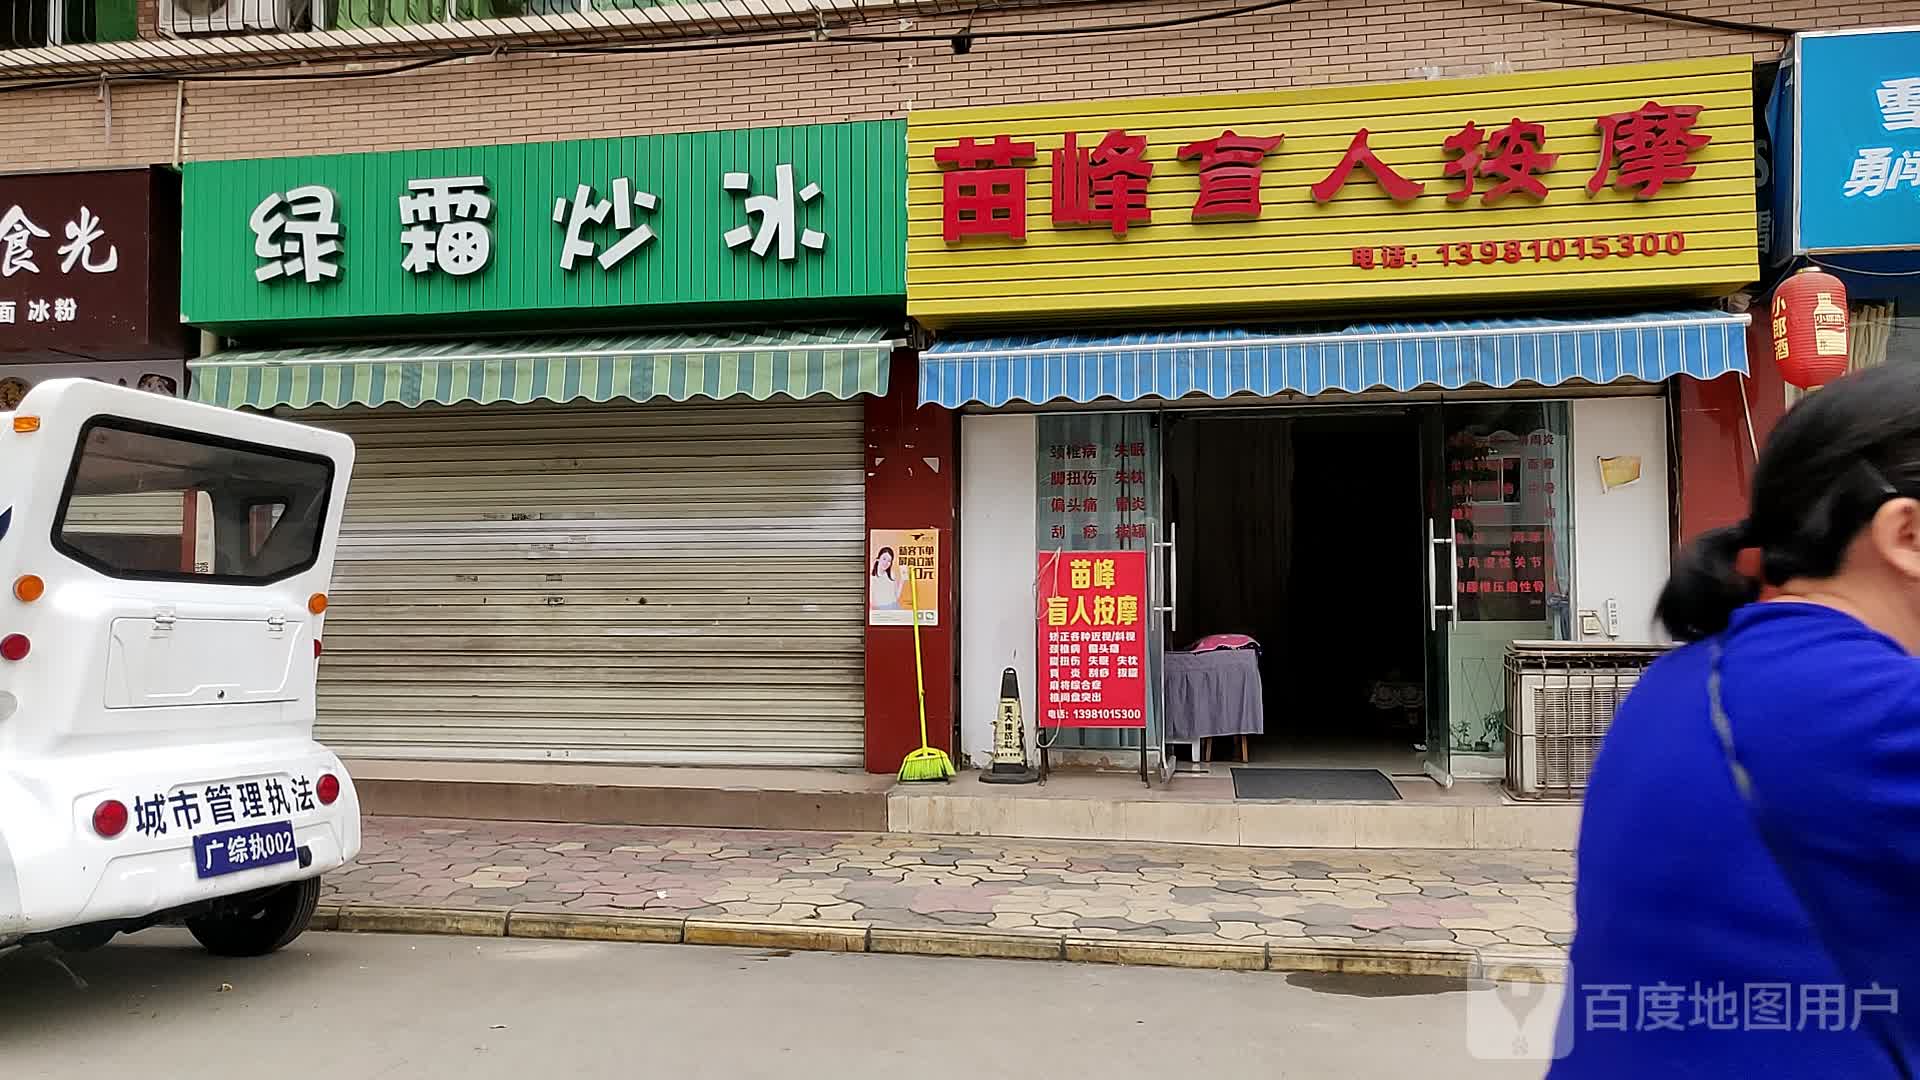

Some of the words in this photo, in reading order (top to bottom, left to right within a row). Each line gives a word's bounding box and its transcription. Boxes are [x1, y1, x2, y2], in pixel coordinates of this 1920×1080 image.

[934, 101, 1711, 245] 苗峰盲人按摩
[0, 204, 118, 277] 食光
[28, 298, 77, 322] 冰粉
[1773, 296, 1788, 360] 小郎酒
[1050, 444, 1097, 460] 颈椎病
[1114, 443, 1145, 458] 失眠
[1051, 497, 1098, 513] 偏头痛
[1070, 559, 1115, 590] 苗峰
[1047, 595, 1139, 626] 盲人按摩
[134, 775, 316, 838] 城市管理执法
[203, 830, 294, 871] 广综执002
